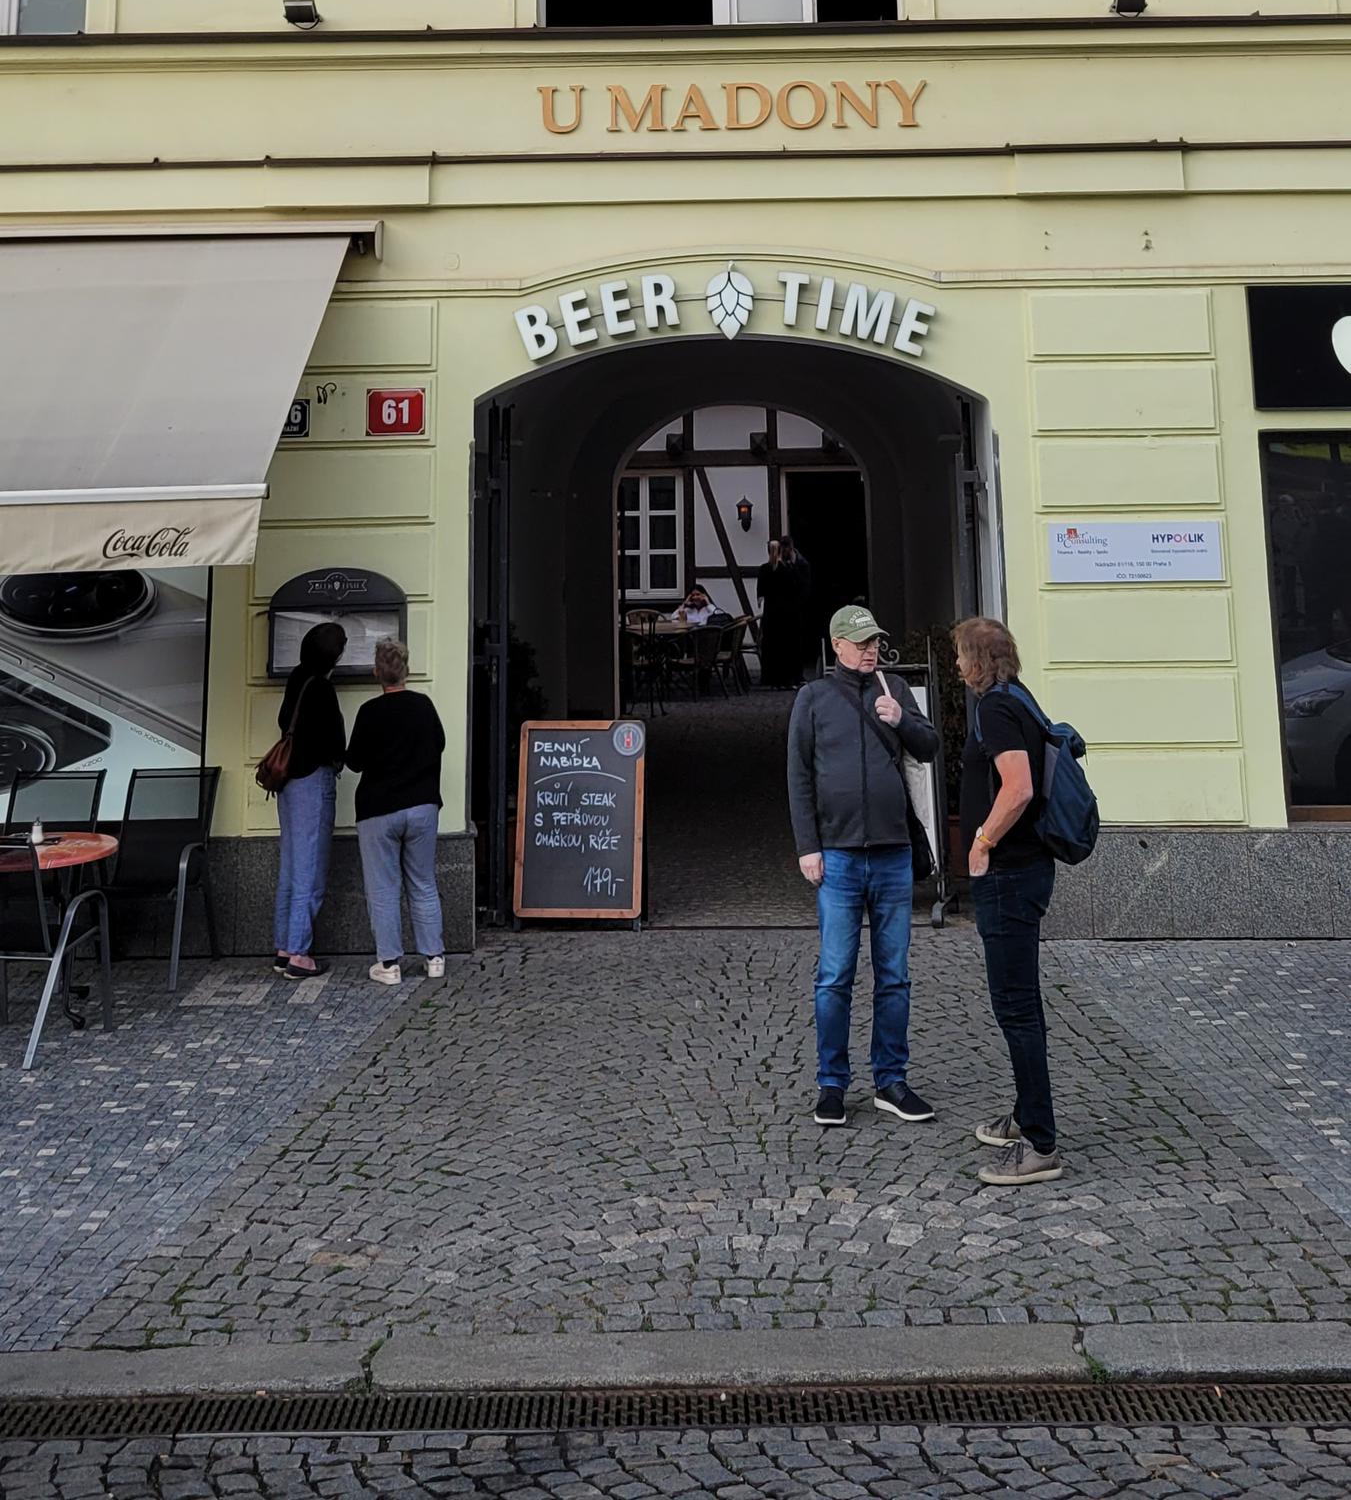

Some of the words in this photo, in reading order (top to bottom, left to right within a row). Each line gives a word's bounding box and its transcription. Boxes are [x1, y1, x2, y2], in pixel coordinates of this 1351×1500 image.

[537, 85, 585, 133] U
[606, 80, 927, 132] MADONY
[513, 274, 681, 362] BEER
[777, 271, 937, 357] TIME
[382, 399, 409, 425] 61
[102, 526, 196, 559] Coca-Cola
[534, 737, 591, 753] DENNÍ
[540, 753, 601, 770] NABÍDKA
[580, 792, 616, 808] STEAK
[534, 812, 544, 827] S
[553, 807, 609, 826] PEPŘOVOU
[589, 828, 621, 850] RÝŽE
